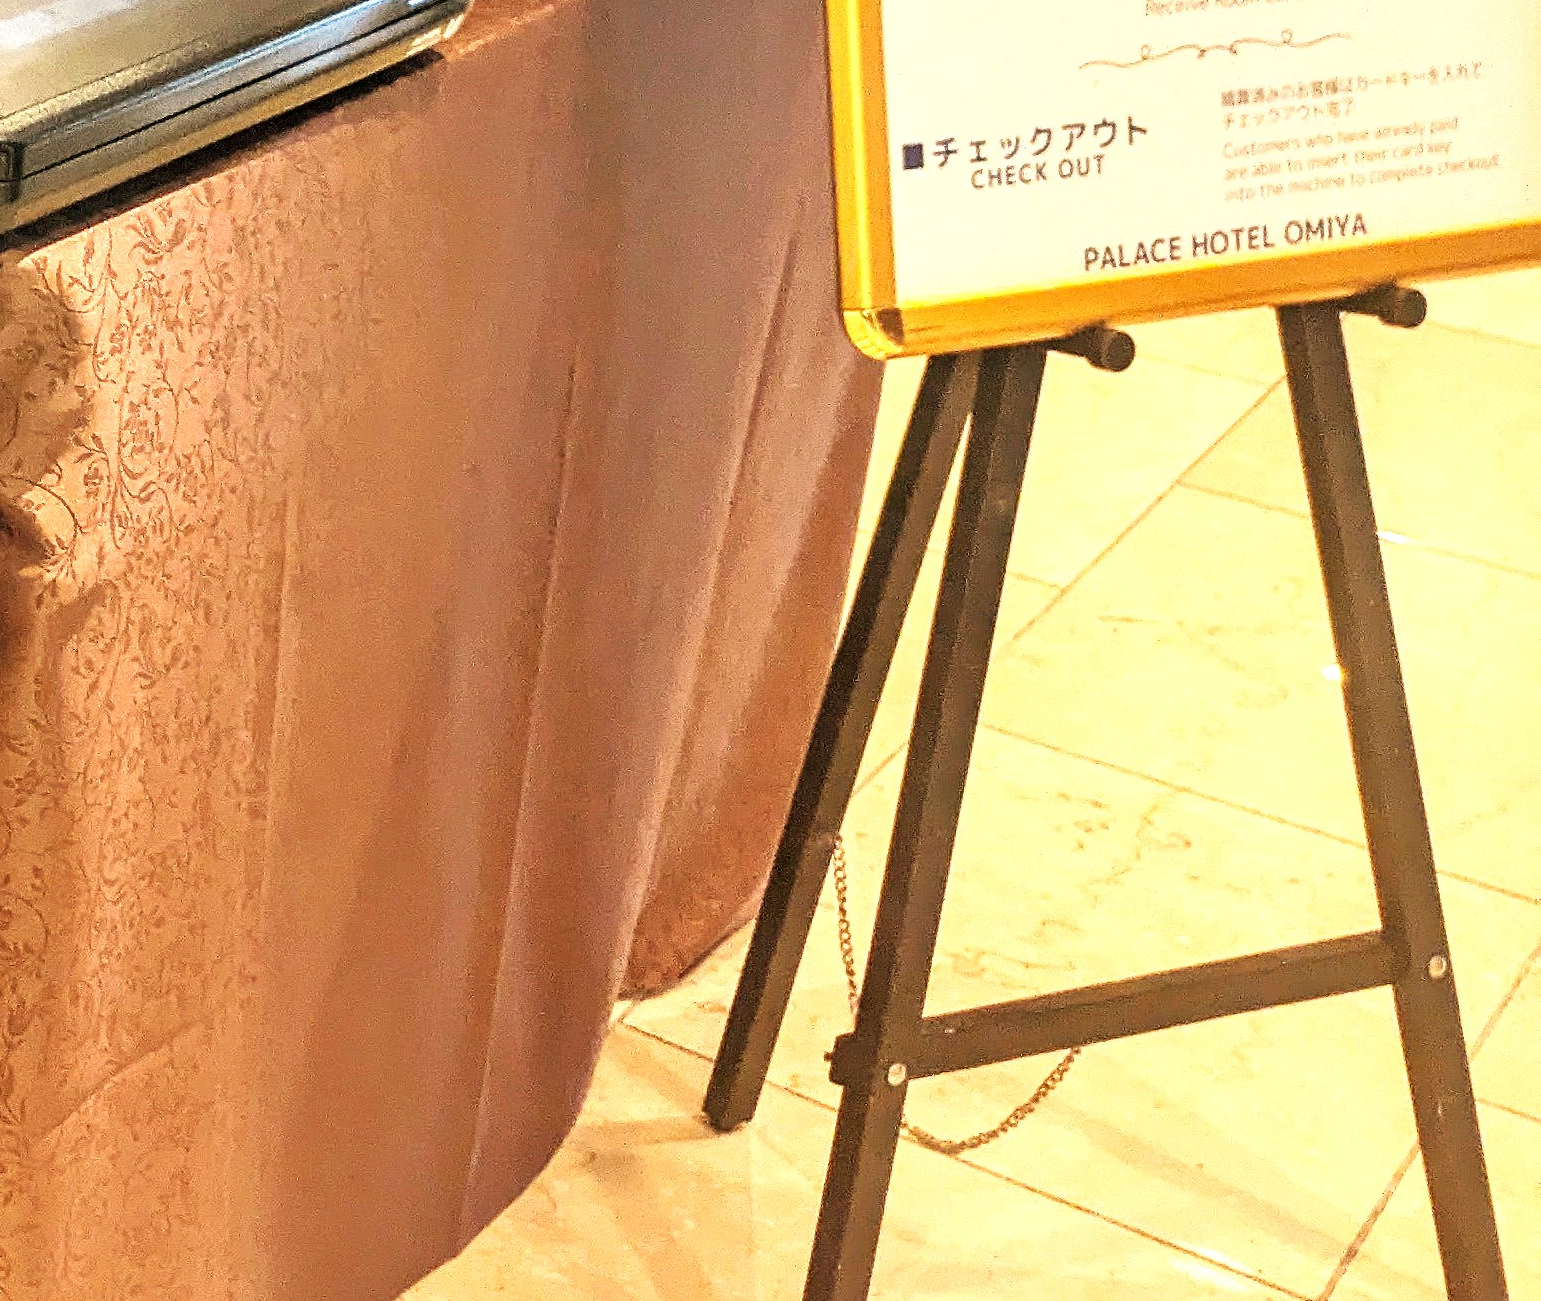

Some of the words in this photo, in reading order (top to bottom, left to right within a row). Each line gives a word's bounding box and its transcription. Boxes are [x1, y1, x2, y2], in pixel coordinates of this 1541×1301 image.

[931, 113, 1149, 168] チェックアウト
[970, 161, 1049, 190] CHECK
[1057, 154, 1108, 182] OUT
[1083, 234, 1184, 271] PALACE
[1191, 224, 1276, 259] HOTEL
[1284, 212, 1369, 246] OMIYA
